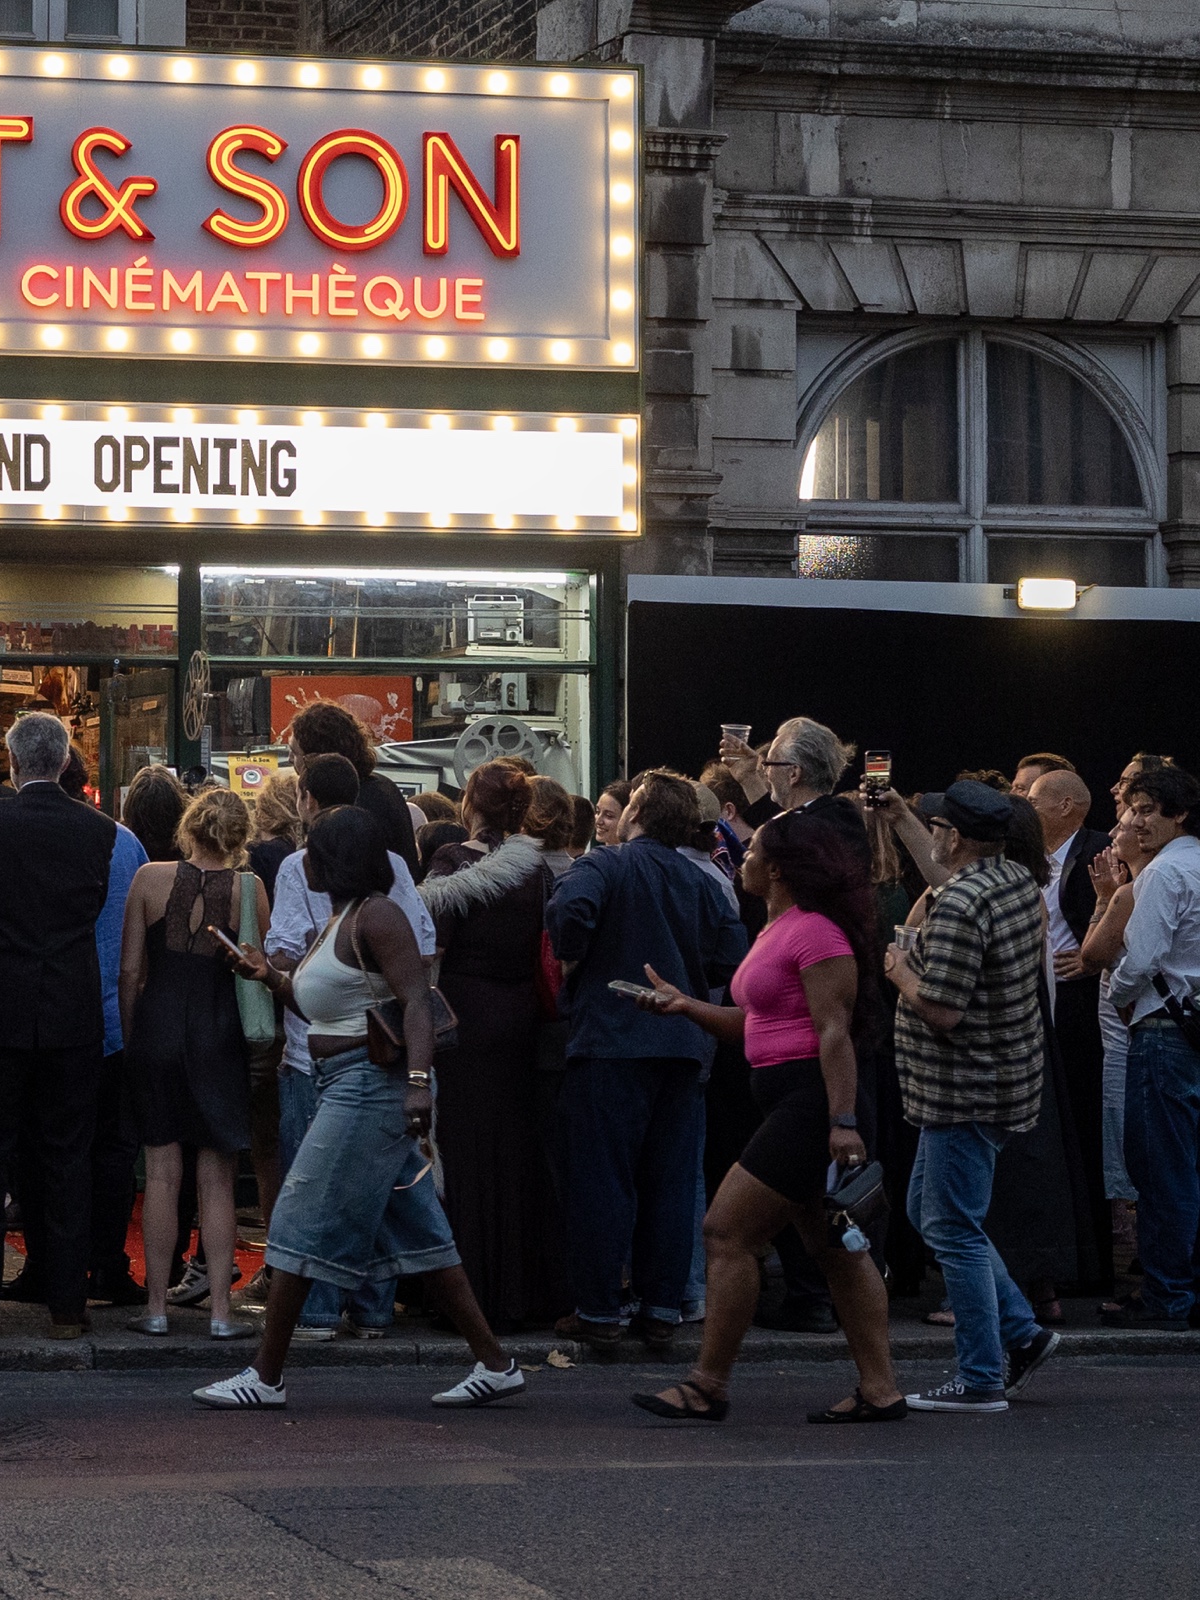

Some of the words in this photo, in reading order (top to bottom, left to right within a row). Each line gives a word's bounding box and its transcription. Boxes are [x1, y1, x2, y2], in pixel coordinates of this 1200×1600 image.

[59, 126, 158, 241] &
[202, 124, 520, 257] SON
[21, 256, 486, 321] CINÉMATHÈQUE
[93, 434, 297, 497] OPENING
